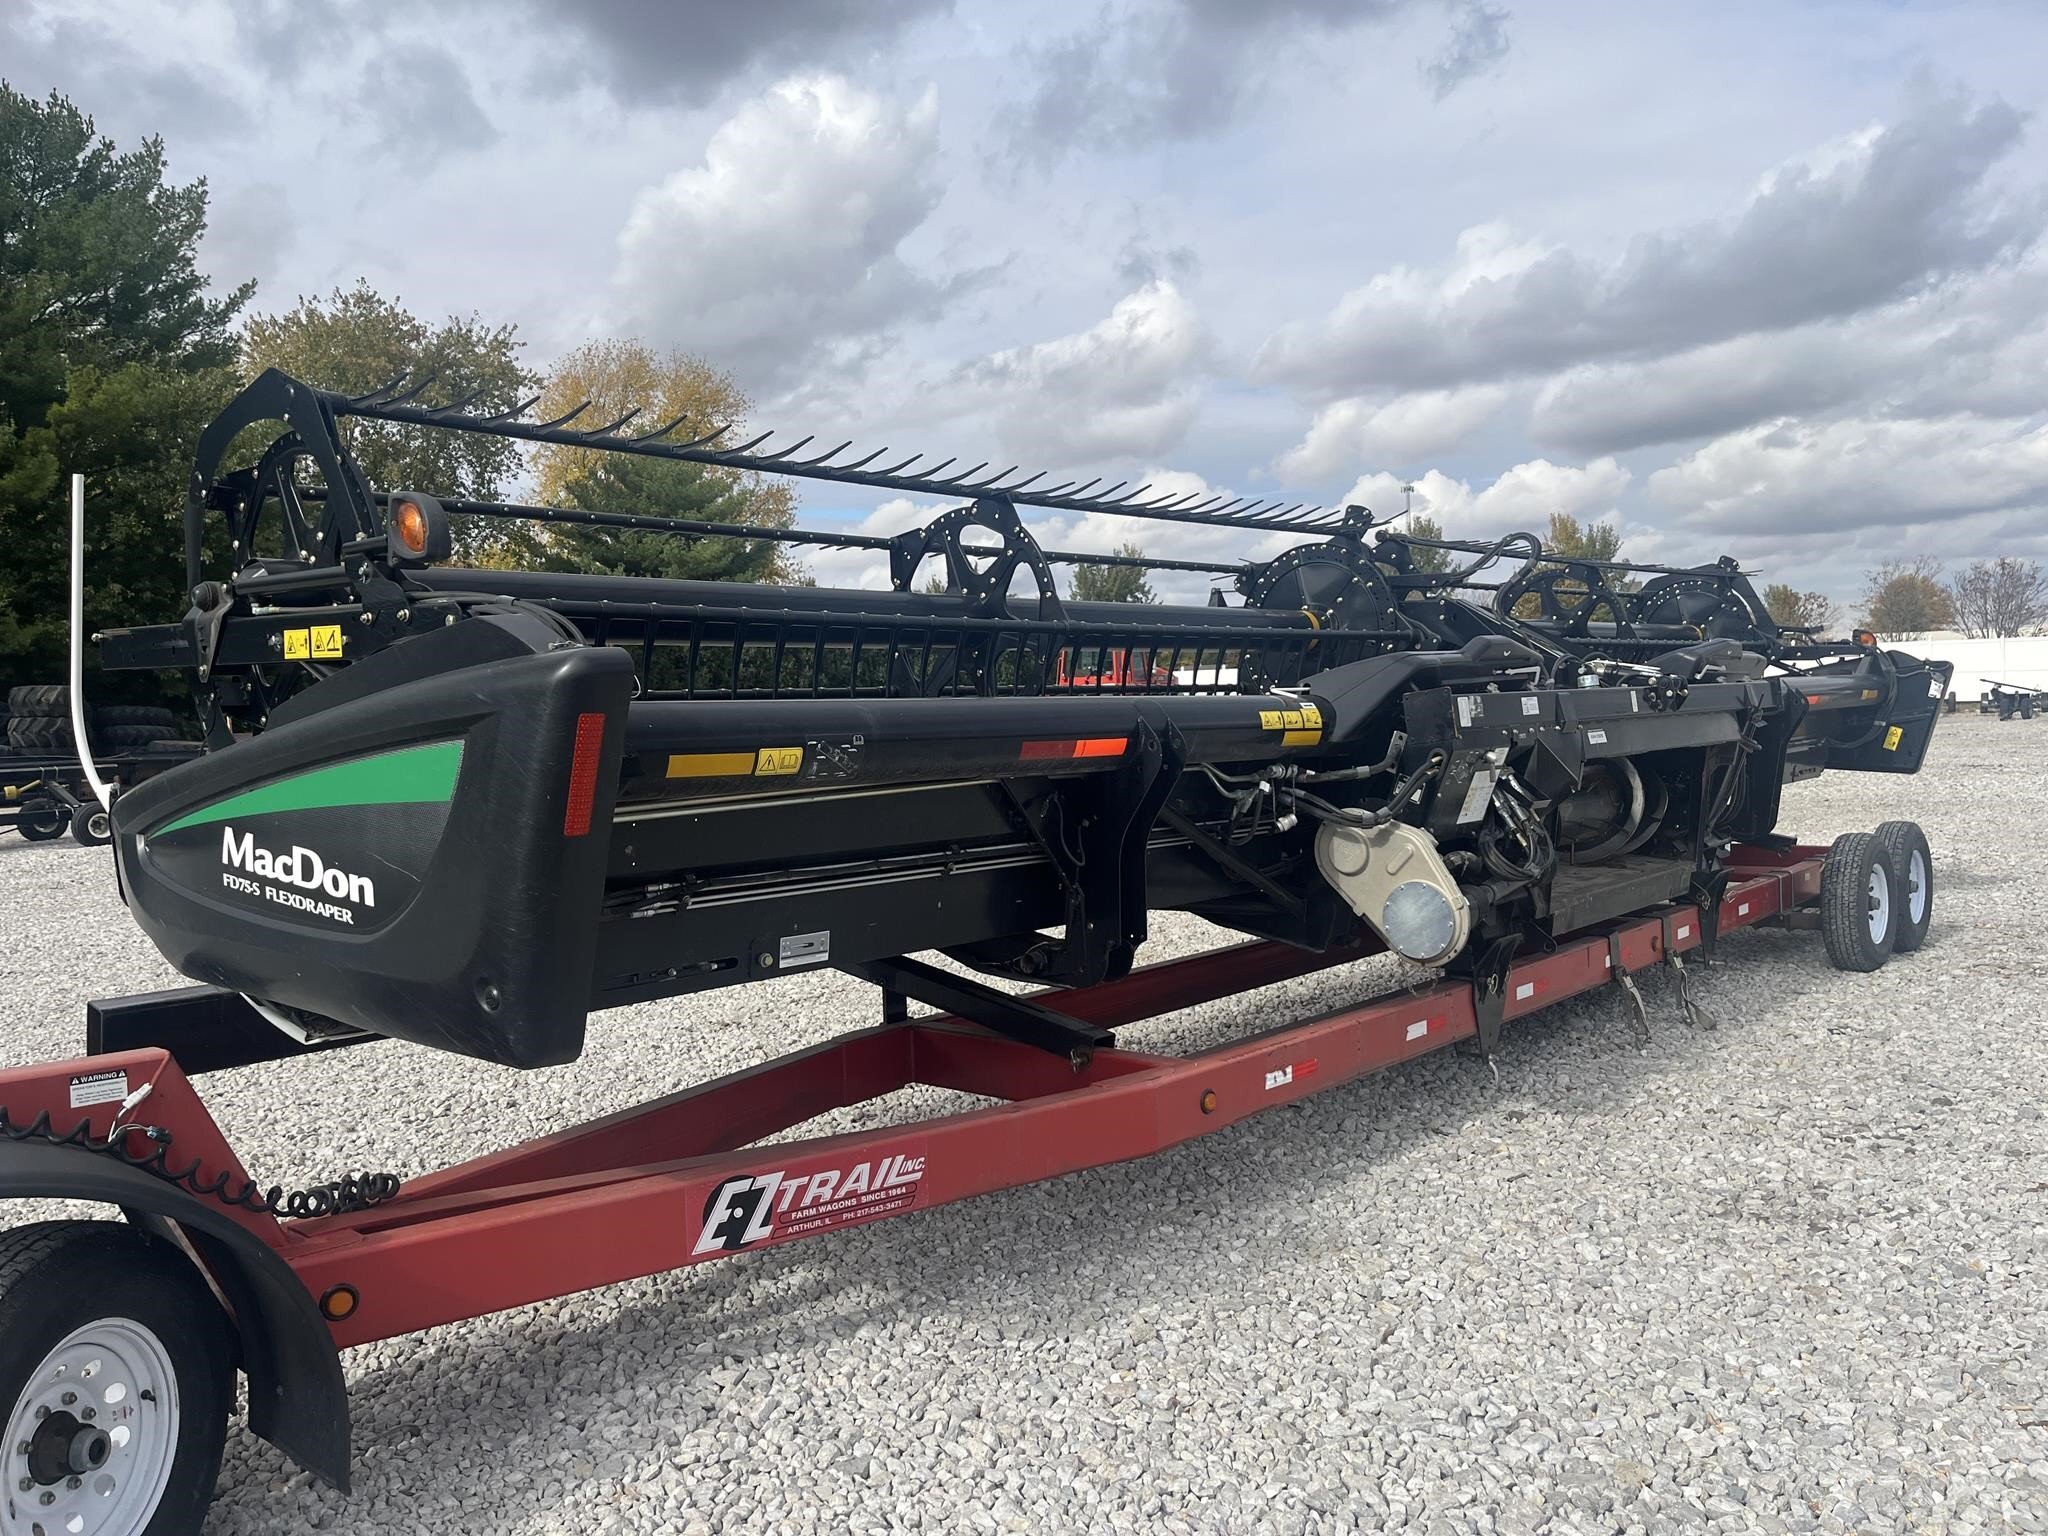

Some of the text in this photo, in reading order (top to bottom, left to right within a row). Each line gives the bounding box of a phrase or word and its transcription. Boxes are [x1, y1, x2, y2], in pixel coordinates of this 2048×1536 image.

[221, 826, 375, 907] MacDon
[265, 885, 354, 925] FLEXDRAPER
[80, 1072, 117, 1083] WARNING
[777, 1154, 923, 1213] TRAIL
[900, 1157, 926, 1174] INC.
[791, 1186, 906, 1221] FARM WAGONS SINCE 1964
[787, 1220, 824, 1235] ARTHUR,
[842, 1211, 856, 1221] PH:
